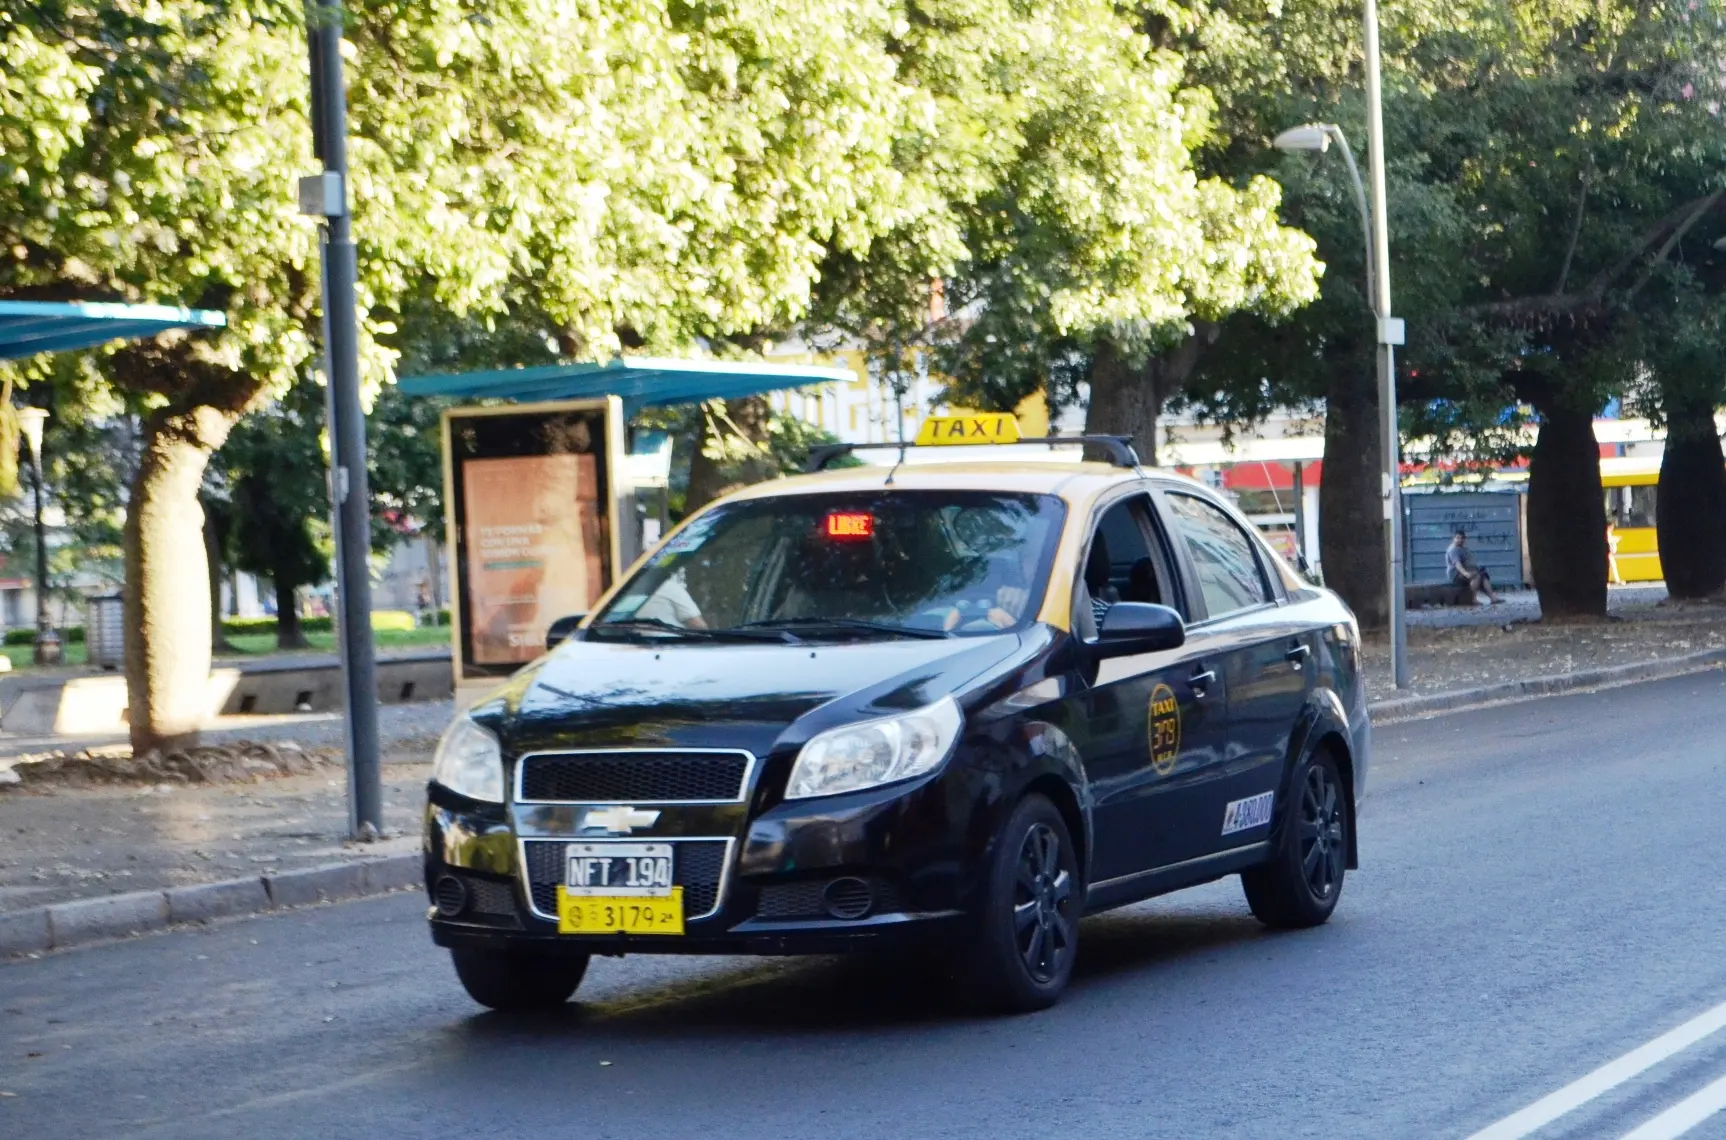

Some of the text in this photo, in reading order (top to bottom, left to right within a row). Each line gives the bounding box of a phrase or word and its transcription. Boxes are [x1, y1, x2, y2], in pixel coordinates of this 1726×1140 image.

[930, 418, 1003, 438] TAXI
[828, 514, 869, 535] LIBRE
[1152, 698, 1175, 717] TAXI
[570, 857, 669, 887] NFT 194
[603, 905, 655, 928] 3179
